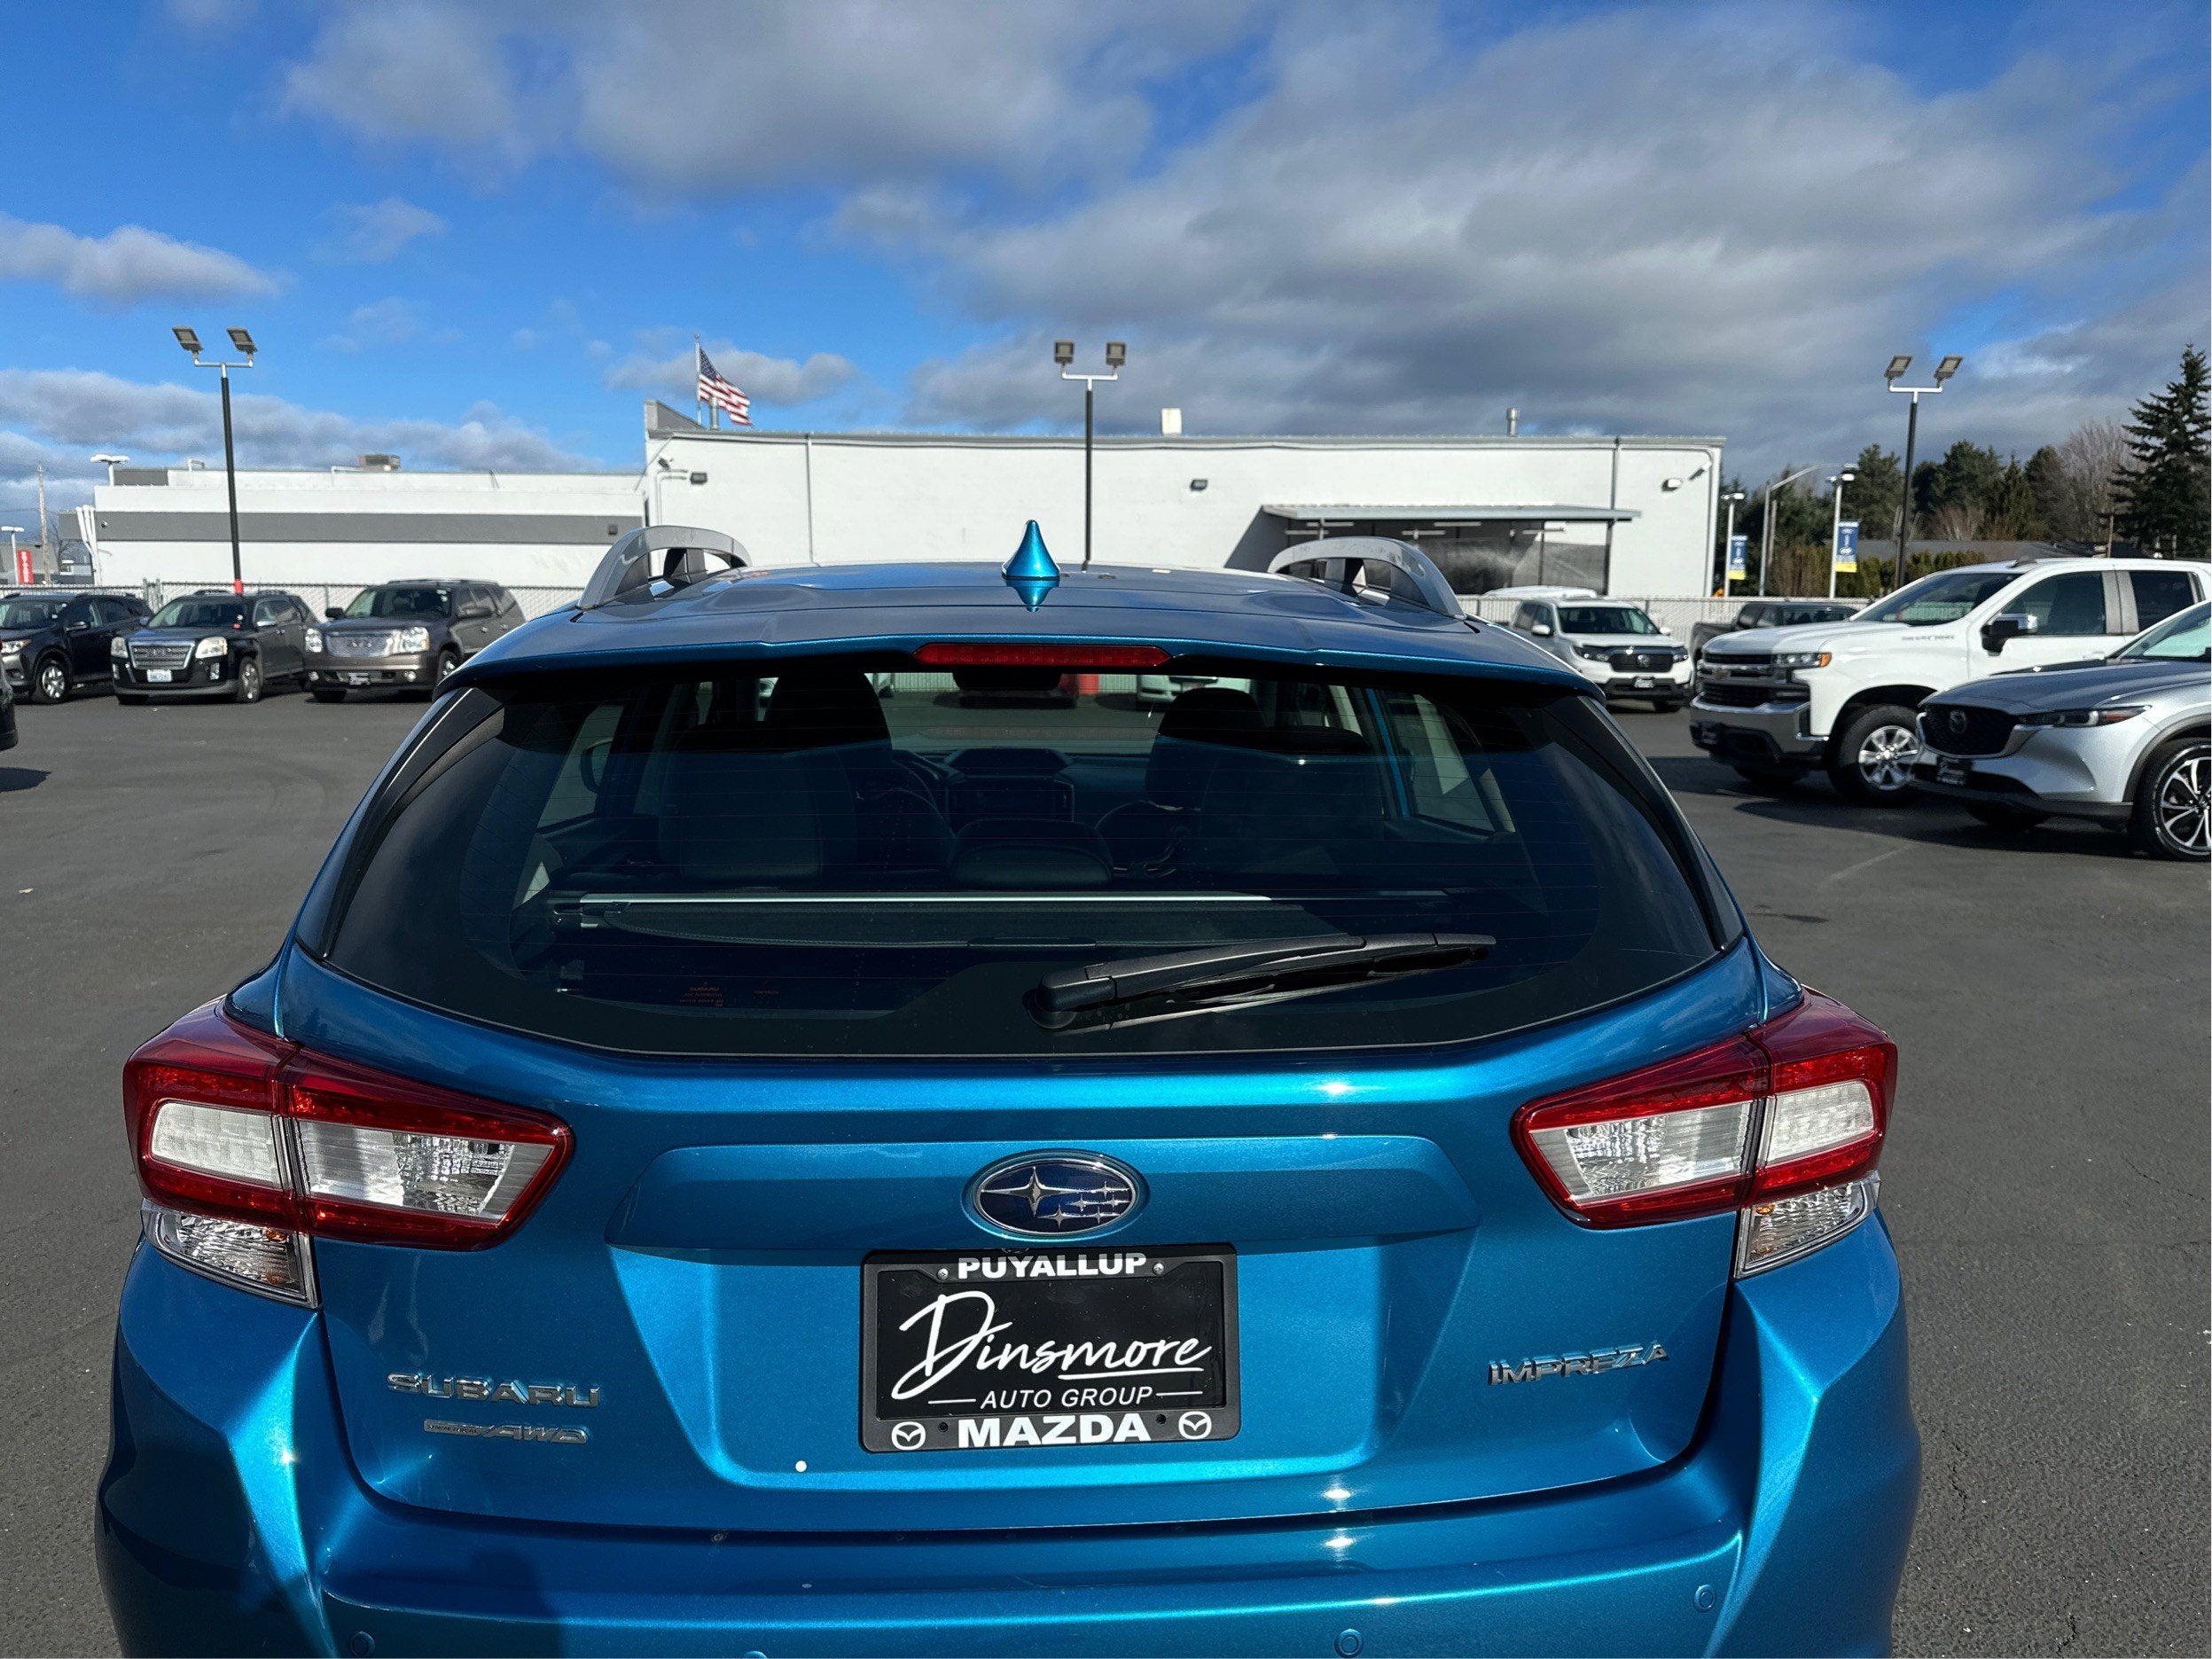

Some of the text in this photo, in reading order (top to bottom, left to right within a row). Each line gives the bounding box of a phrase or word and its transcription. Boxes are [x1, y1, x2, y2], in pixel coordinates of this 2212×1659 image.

[957, 1253, 1147, 1279] PUYALLUP
[891, 1290, 1212, 1400] Dinsmore
[1488, 1342, 1669, 1385] IMPREZA
[387, 1373, 601, 1407] SUBARU
[980, 1386, 1153, 1410] AUTO GROUP
[483, 1424, 589, 1444] AWD
[957, 1412, 1152, 1448] MAZDA
